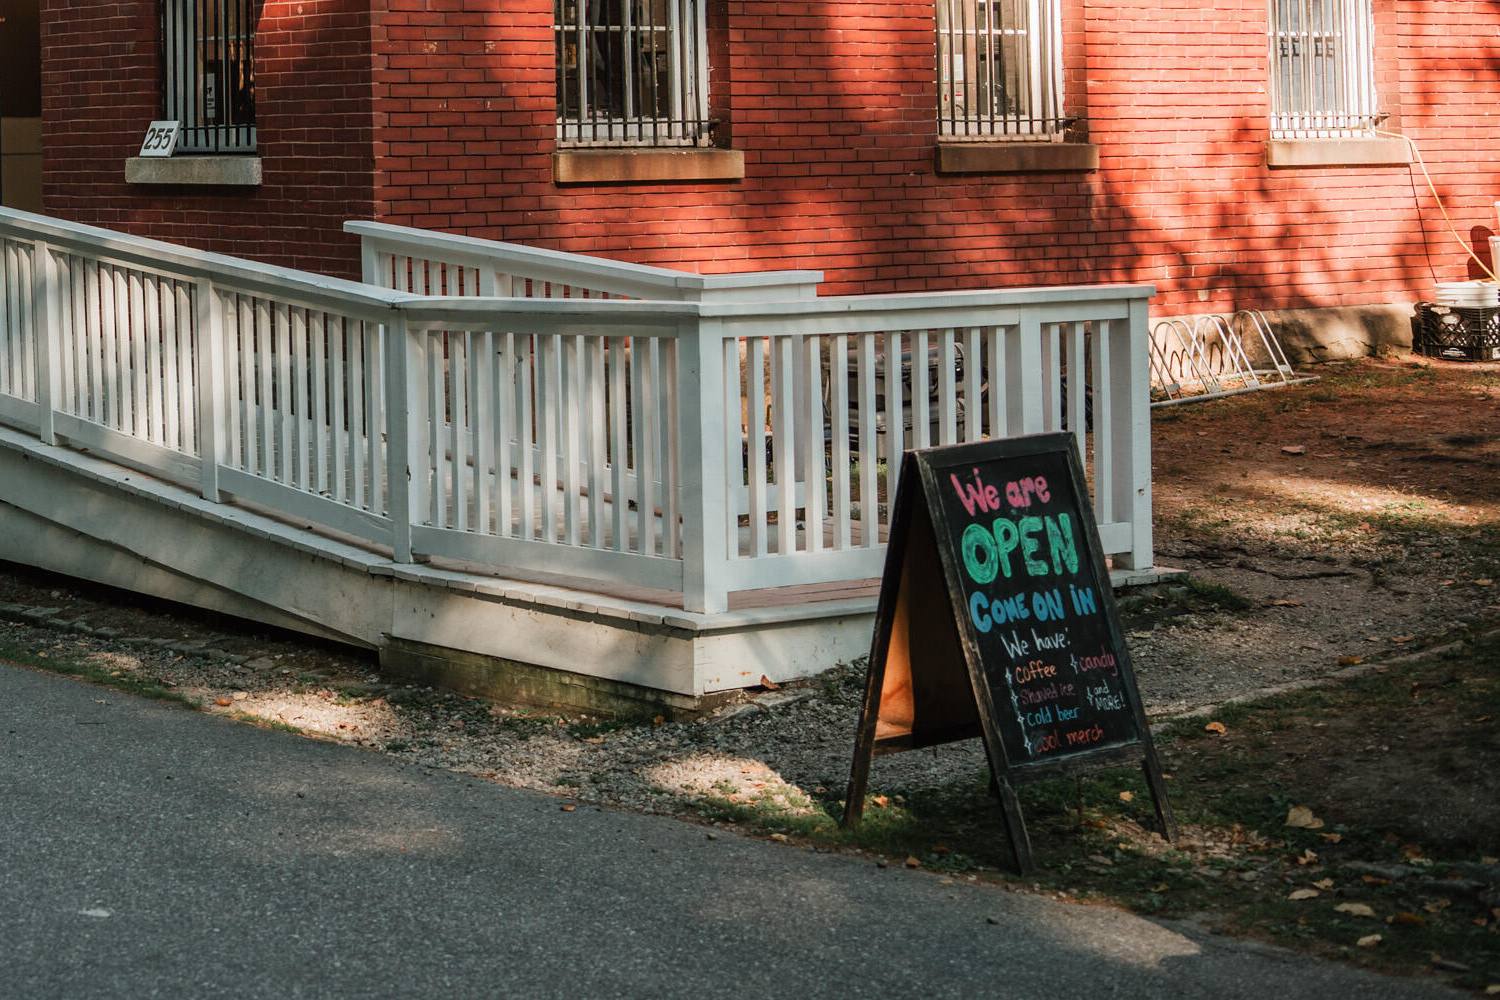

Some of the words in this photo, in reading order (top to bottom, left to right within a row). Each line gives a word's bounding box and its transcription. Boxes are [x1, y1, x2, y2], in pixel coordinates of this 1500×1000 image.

[143, 127, 174, 150] 255
[950, 467, 1000, 517] We
[1006, 476, 1050, 507] are
[961, 512, 1079, 584] OPEN
[1032, 588, 1065, 621] ON
[1001, 629, 1029, 659] We
[1079, 645, 1118, 677] candy
[1093, 679, 1110, 695] and
[1055, 704, 1080, 722] beer
[1065, 723, 1104, 745] merch
